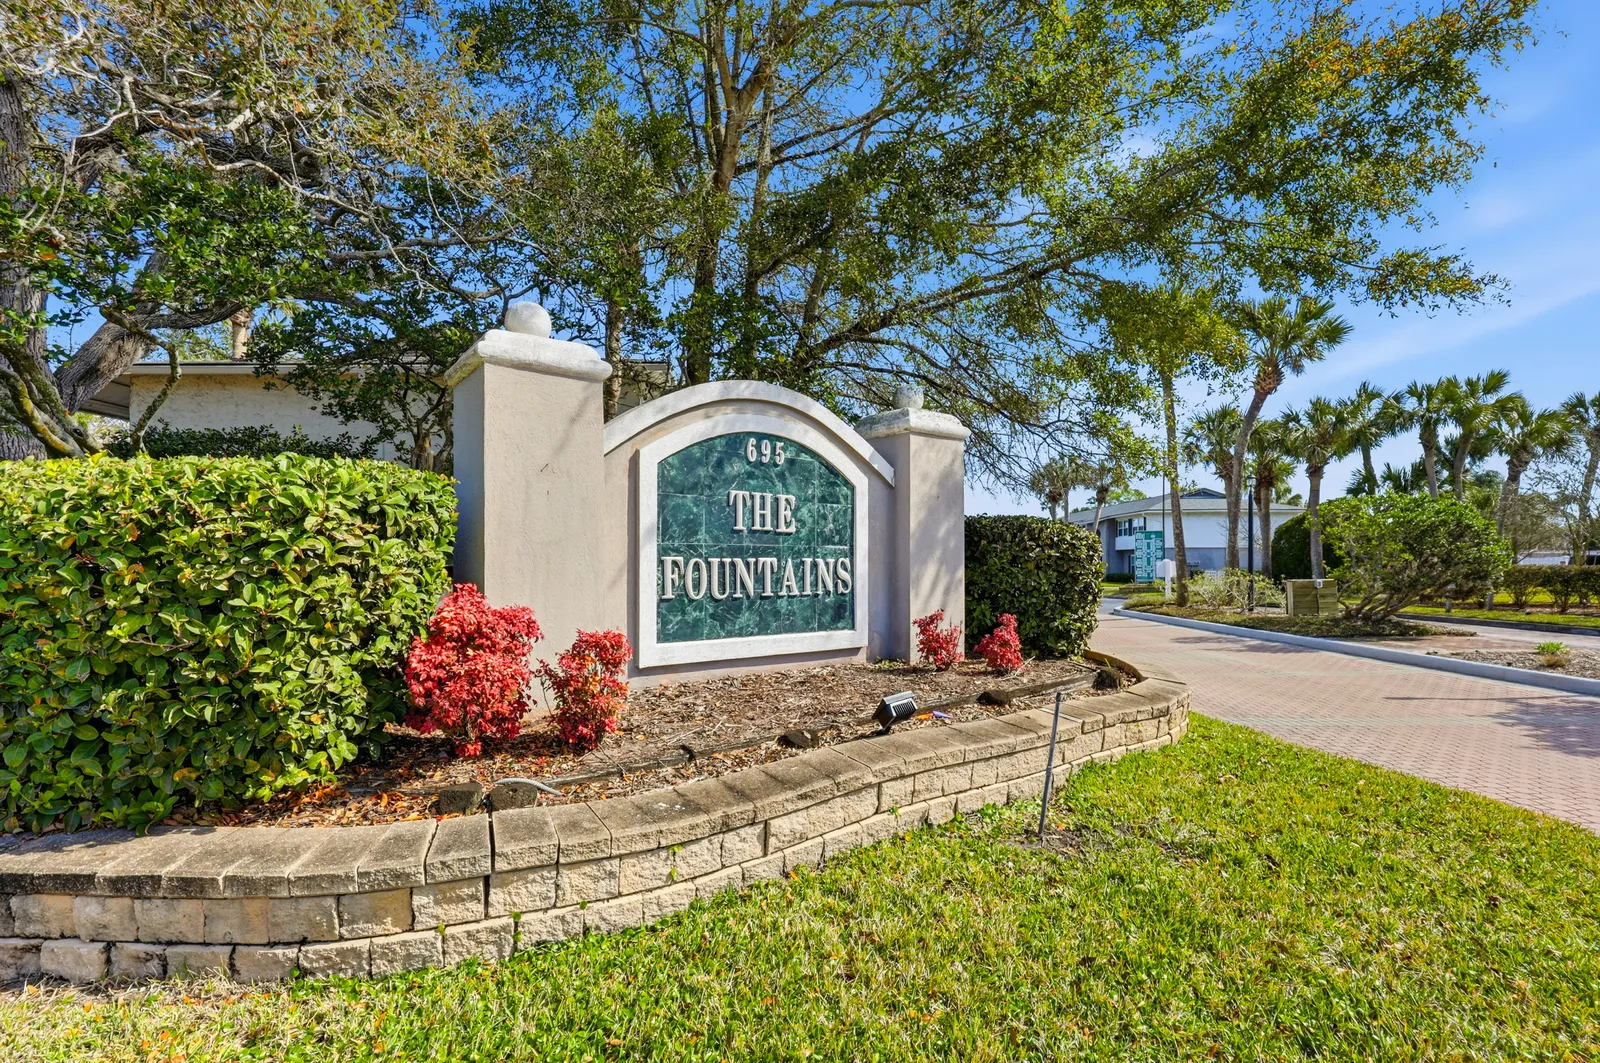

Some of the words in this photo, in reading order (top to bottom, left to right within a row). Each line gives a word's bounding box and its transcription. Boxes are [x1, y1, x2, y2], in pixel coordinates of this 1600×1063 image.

[746, 437, 785, 465] 695
[729, 490, 796, 534] THE
[660, 556, 852, 600] FOUNTAINS
